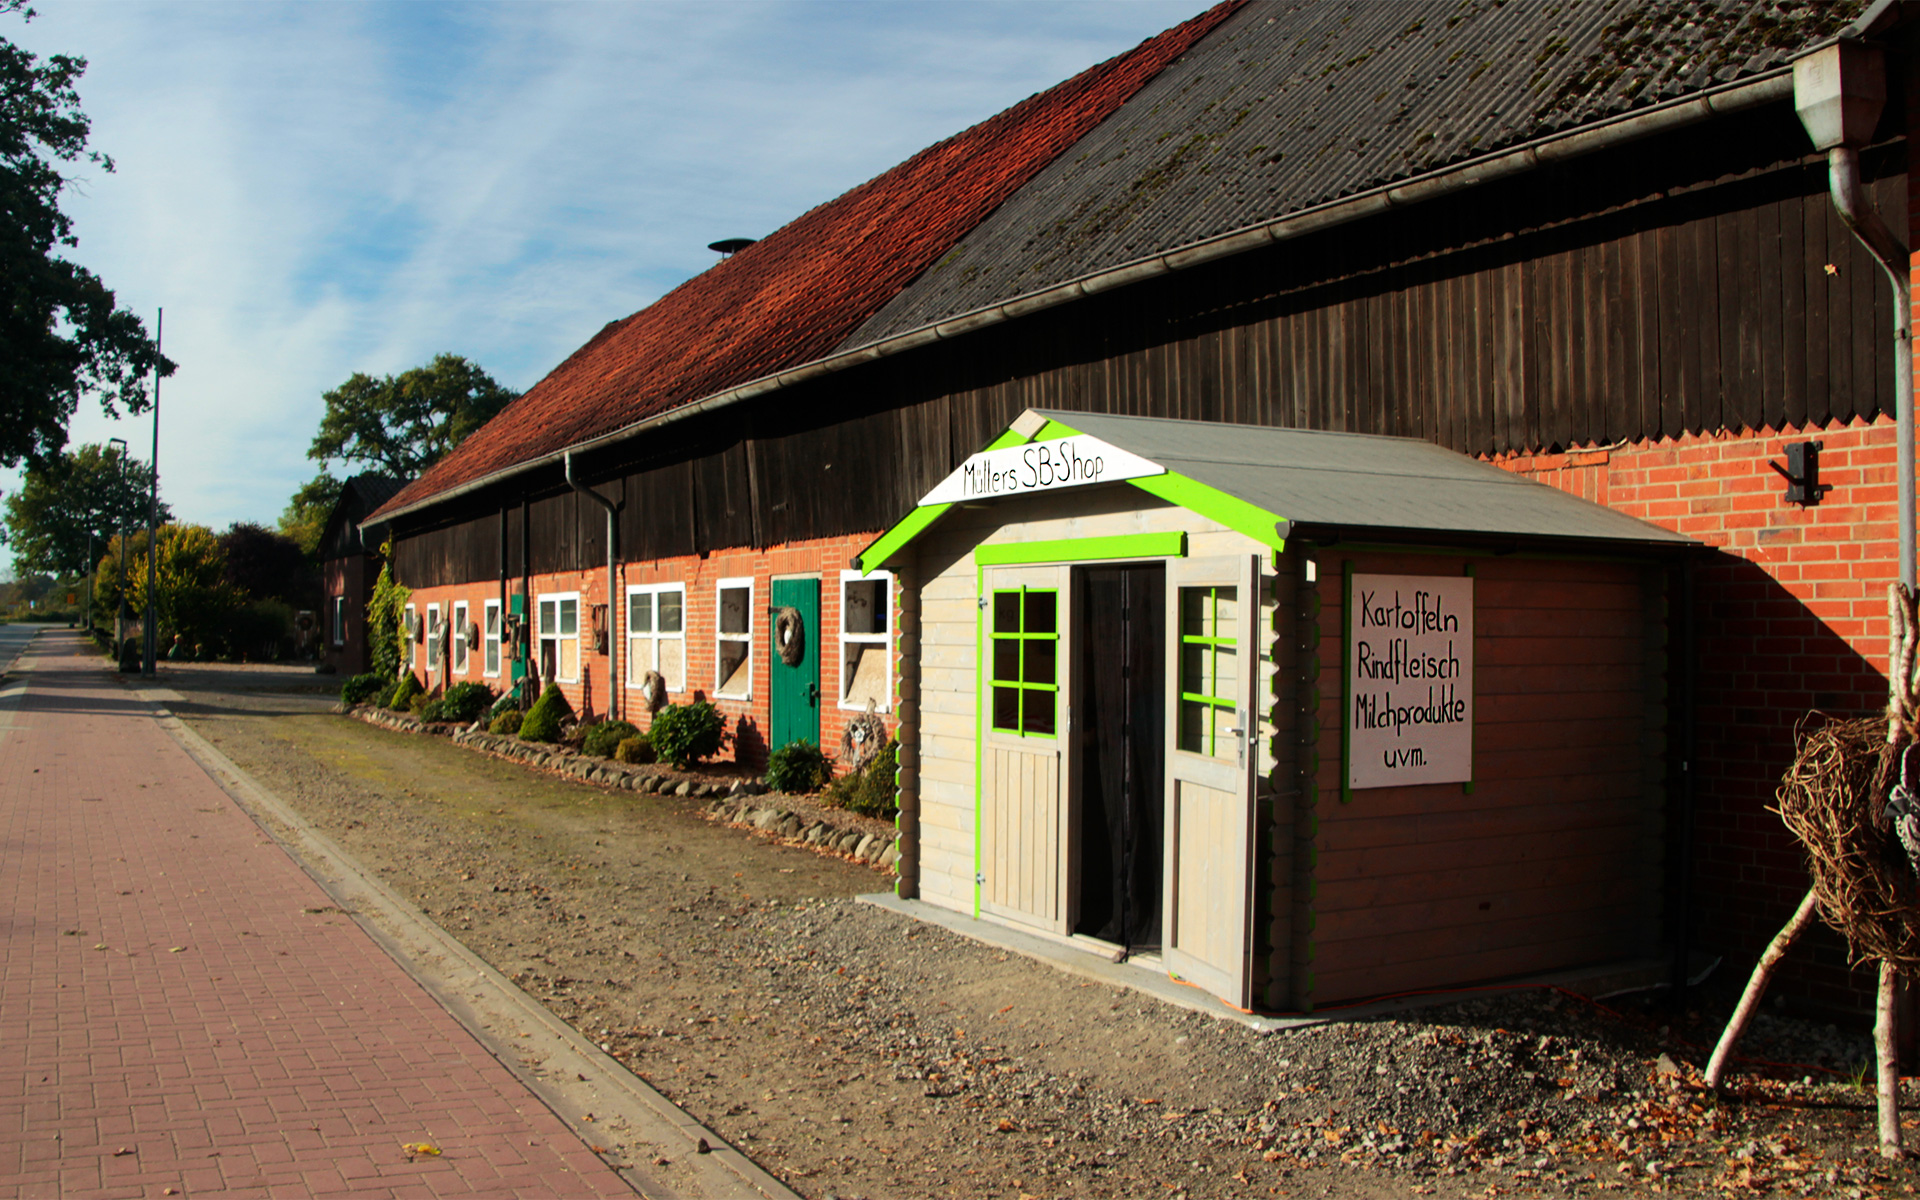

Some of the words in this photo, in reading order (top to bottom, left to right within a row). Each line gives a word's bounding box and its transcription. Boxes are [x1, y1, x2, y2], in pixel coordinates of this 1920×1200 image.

[964, 459, 1017, 496] Müllers
[1022, 441, 1104, 488] SB-Shop
[1361, 590, 1458, 635] Kartoffeln
[1358, 638, 1459, 684] Rindfleisch
[1355, 683, 1465, 737] Milchprodukte
[1384, 748, 1427, 768] uvm.
